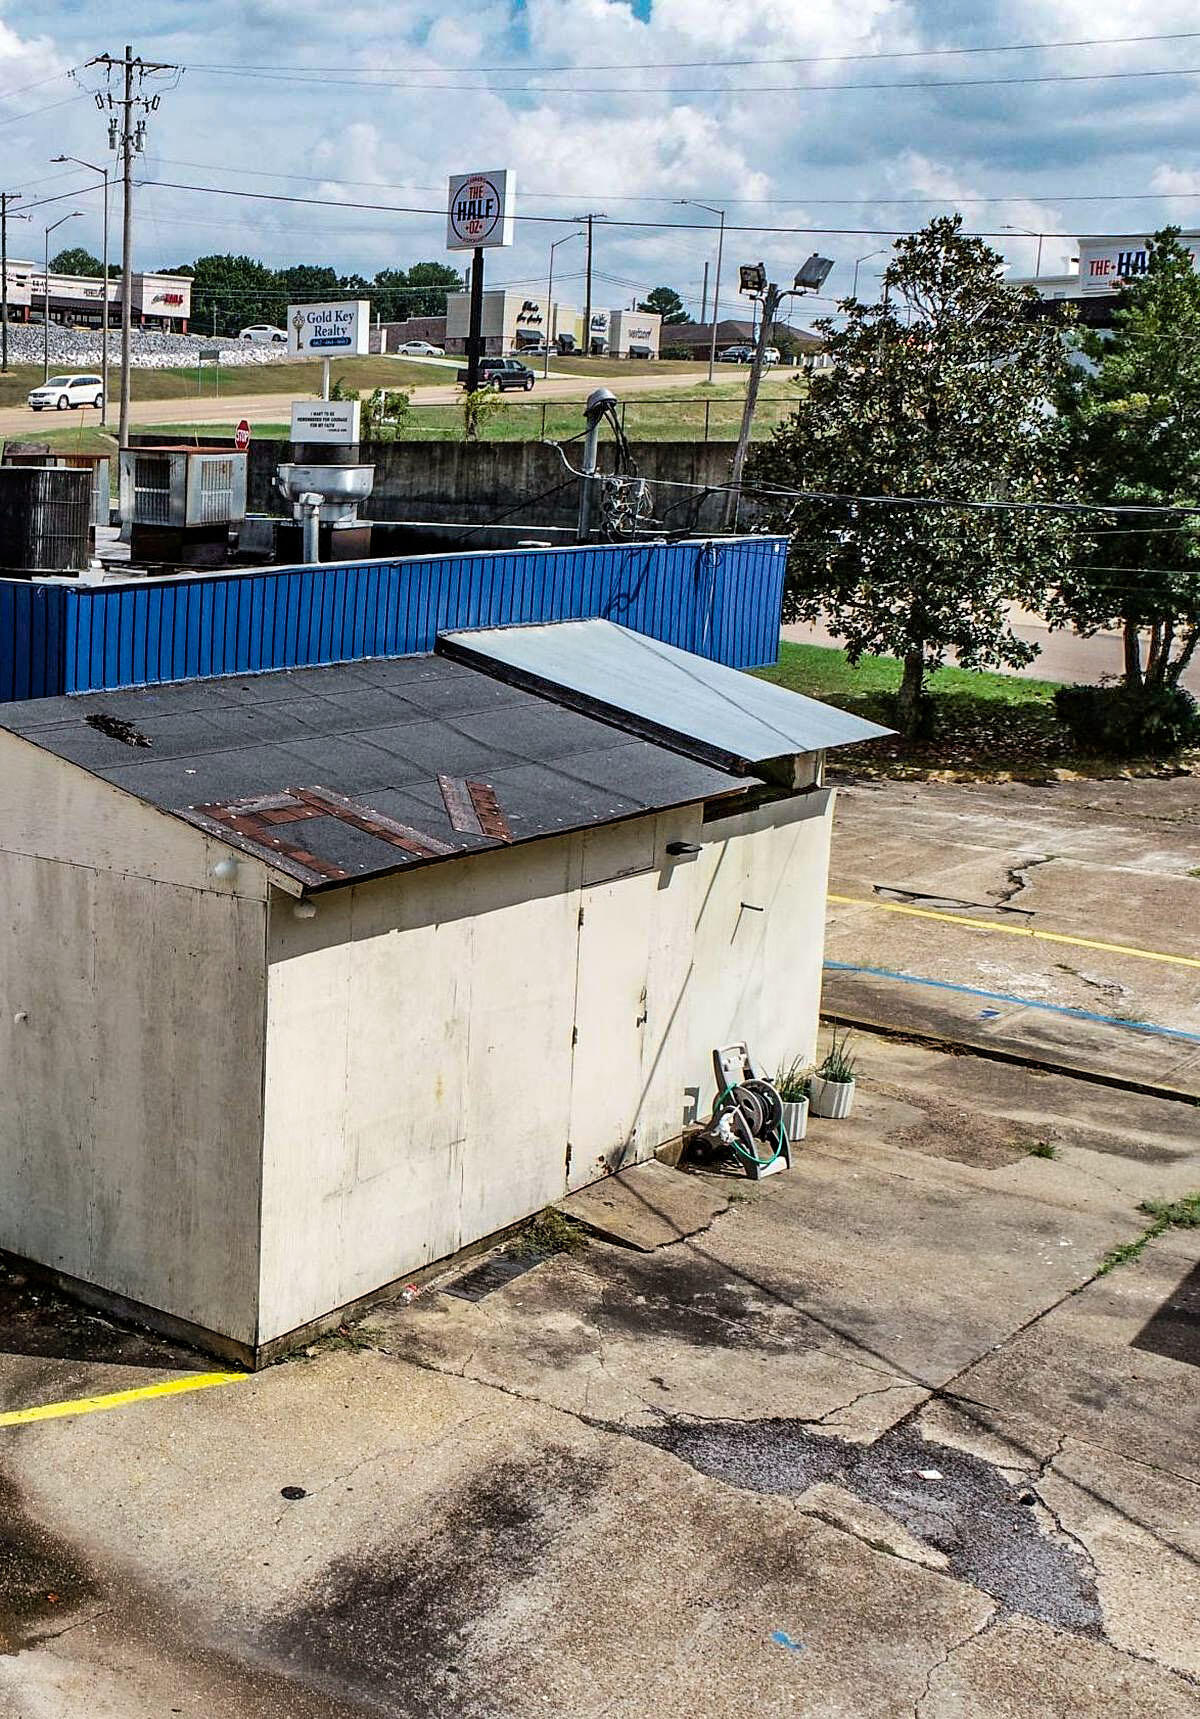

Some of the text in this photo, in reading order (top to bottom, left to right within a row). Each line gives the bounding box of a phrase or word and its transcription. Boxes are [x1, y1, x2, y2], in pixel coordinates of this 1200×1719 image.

[469, 186, 484, 199] THE
[457, 198, 494, 221] HALF
[1089, 260, 1110, 276] THE
[307, 310, 355, 325] Gold Key
[314, 324, 348, 337] Realty
